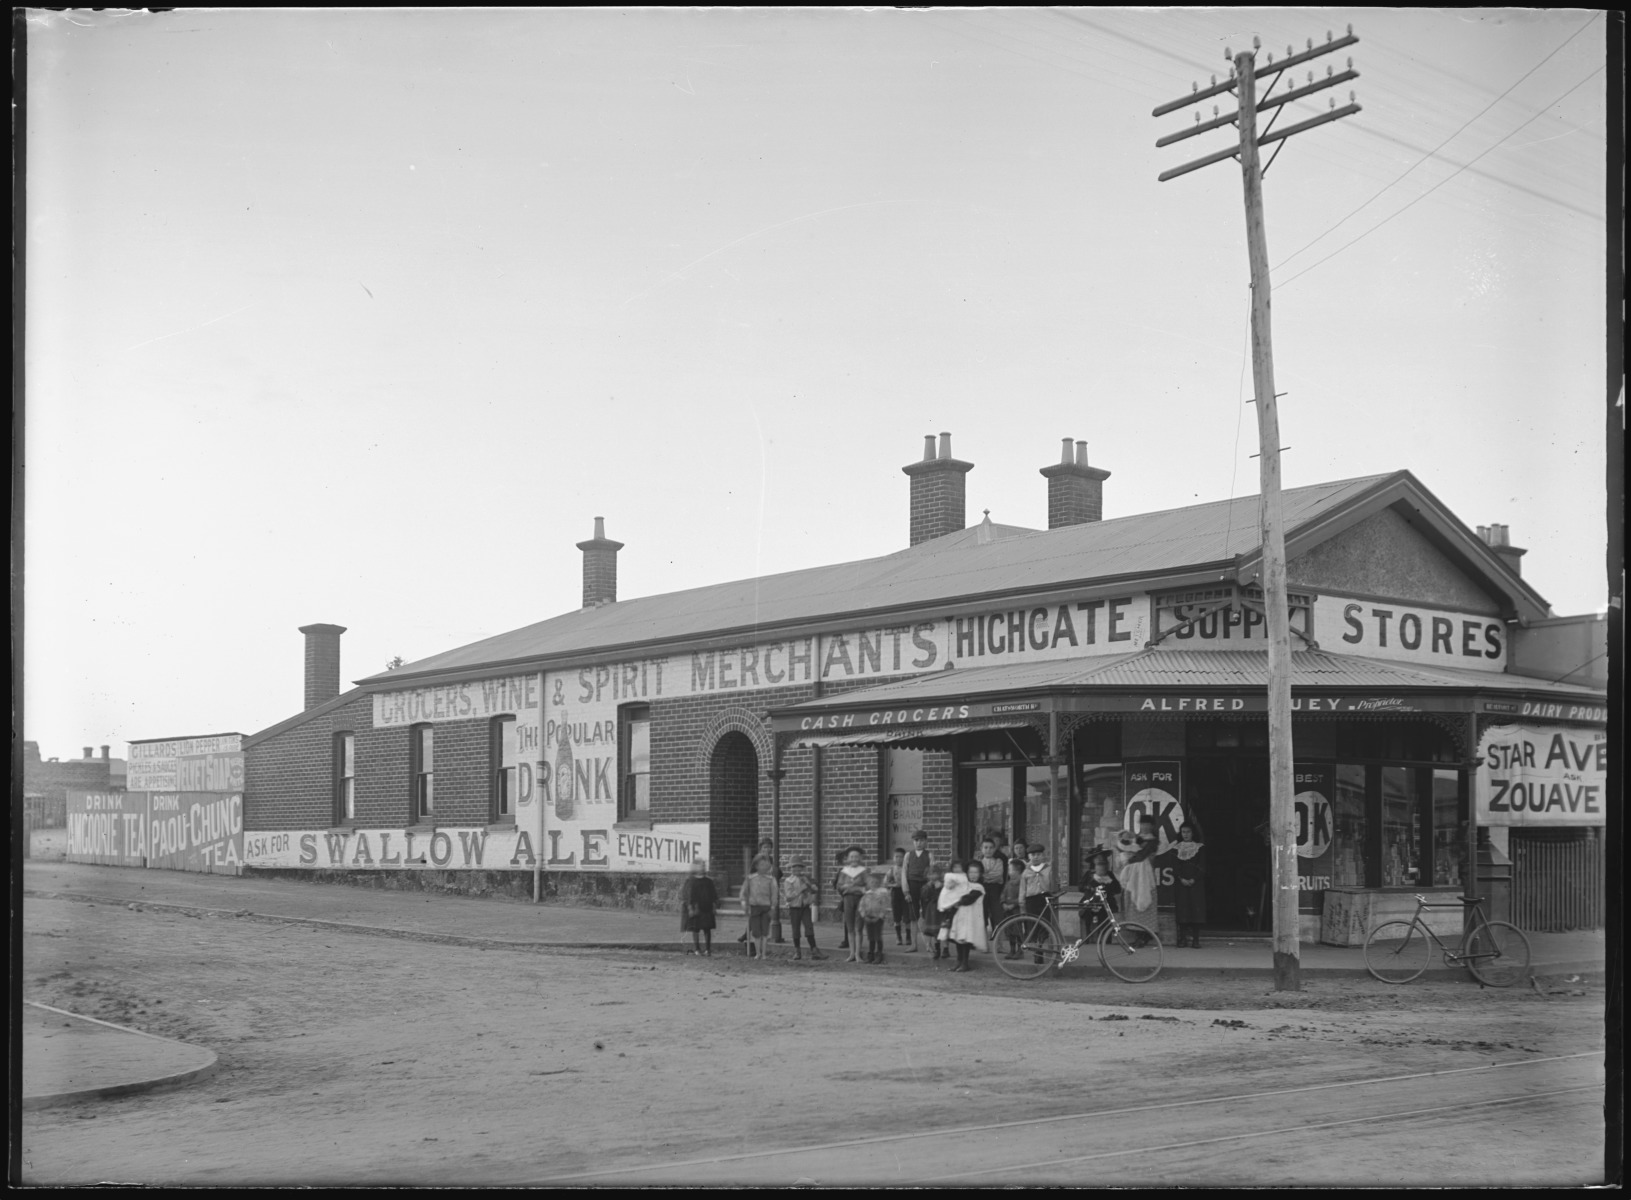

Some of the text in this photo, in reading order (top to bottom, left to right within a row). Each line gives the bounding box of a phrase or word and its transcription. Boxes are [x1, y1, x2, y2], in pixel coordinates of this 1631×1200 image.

[956, 597, 1132, 658] HIGHGATE
[1174, 601, 1297, 640] SUPP
[1342, 603, 1502, 659] STORES
[482, 674, 538, 714] WINE
[552, 678, 566, 706] &
[578, 658, 669, 703] SPIRIT
[691, 622, 938, 693] MERCHANTS
[1140, 697, 1245, 711] ALFRED
[1522, 702, 1563, 718] DAIRY
[801, 705, 970, 731] CASH GROCERS
[131, 742, 177, 759] GILLARDS
[1487, 740, 1537, 770] STAR
[1130, 771, 1174, 782] ASK FOR
[1295, 773, 1324, 783] BEST
[1562, 772, 1583, 783] ASK
[86, 794, 123, 810] DRINK
[153, 795, 180, 811] DRINK
[1489, 779, 1601, 814] ZOUAVE
[122, 813, 147, 857] TEA
[1129, 801, 1180, 844] OK
[1294, 801, 1331, 846] OK
[246, 828, 702, 868] ASK FOR SWALLOW ALE EVERYTIME
